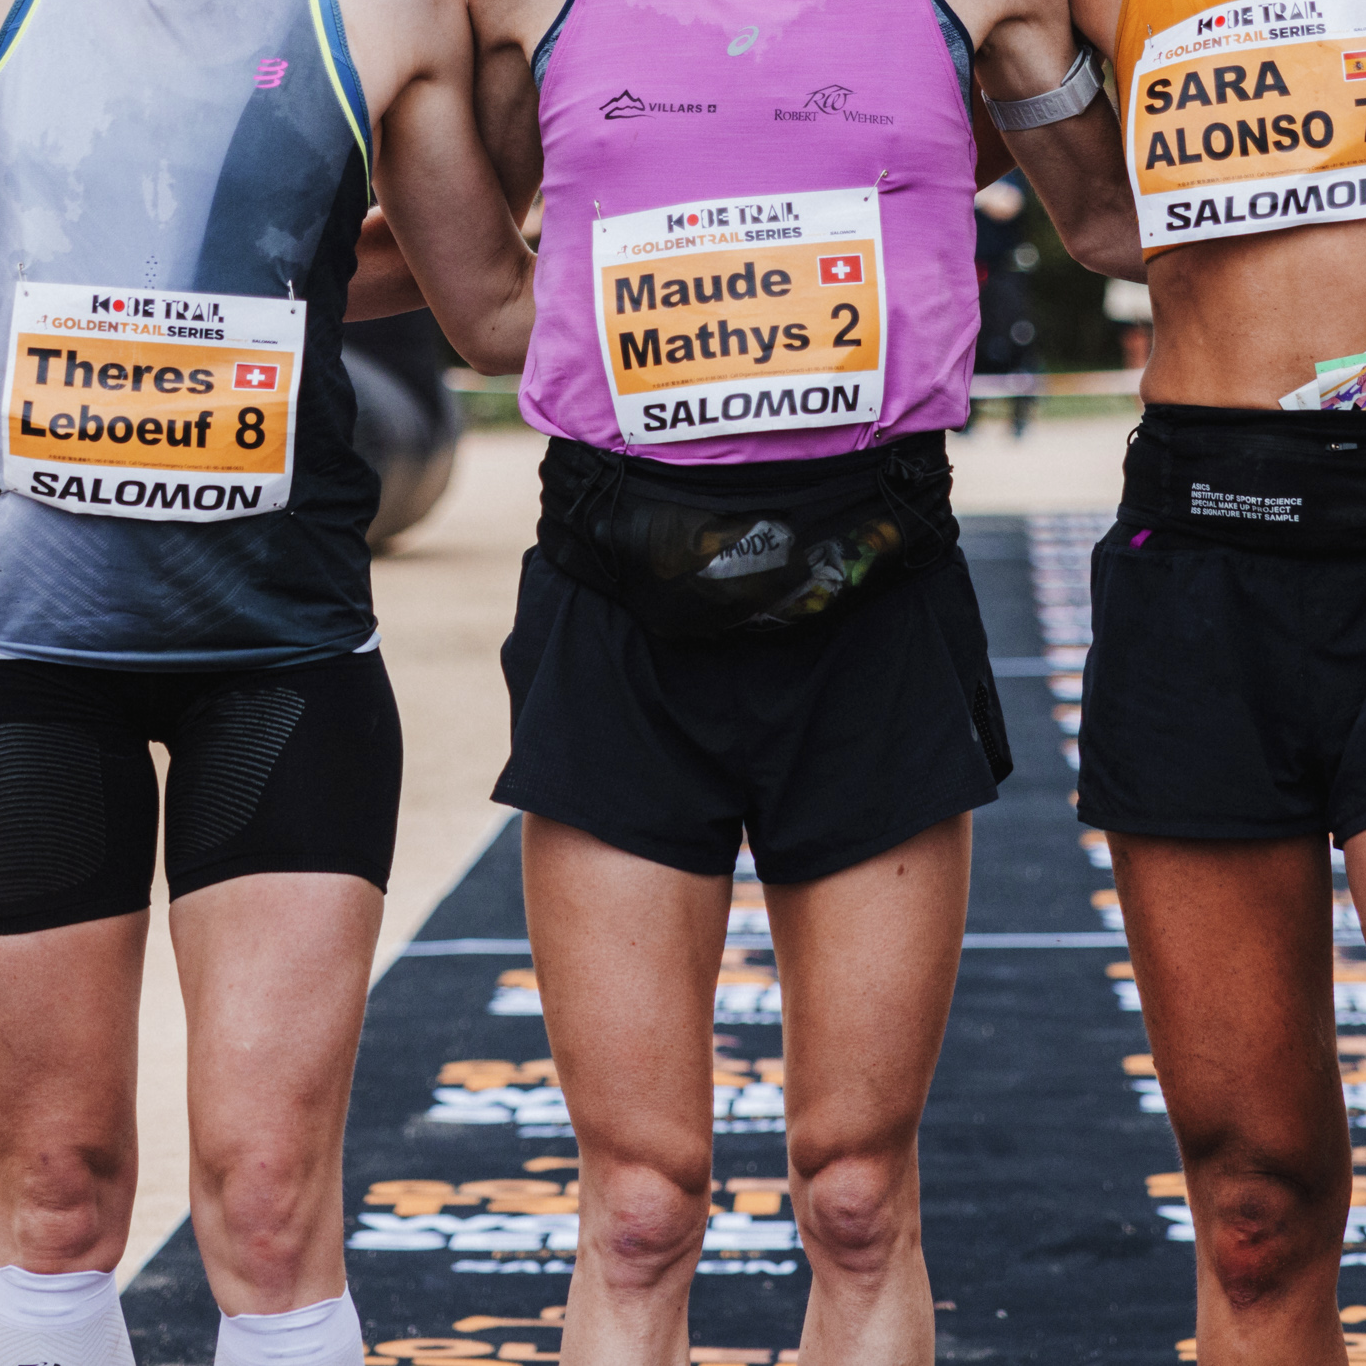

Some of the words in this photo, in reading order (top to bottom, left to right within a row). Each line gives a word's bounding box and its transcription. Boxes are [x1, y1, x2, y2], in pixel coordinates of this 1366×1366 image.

[1258, 0, 1323, 25] TRAIL
[1143, 59, 1291, 116] SARA
[648, 102, 703, 113] VILLARS
[1144, 109, 1334, 170] ALONSO
[735, 202, 800, 226] TRAIL
[614, 261, 793, 316] Maude
[162, 298, 225, 324] TRAIL
[618, 319, 811, 372] Mathys
[829, 302, 863, 348] 2
[26, 347, 216, 396] Theres
[643, 384, 860, 432] SALOMON
[19, 400, 212, 449] Leboeuf
[235, 406, 266, 450] 8
[30, 471, 262, 511] SALOMON
[1191, 483, 1211, 491] ASICS
[1191, 491, 1224, 501] INSTITUTE
[1225, 494, 1234, 502] OF
[1236, 495, 1262, 506] SPORT
[1264, 497, 1302, 506] SCIENCE
[1191, 499, 1217, 508] SPECIAL
[1218, 501, 1238, 510] MAKE
[1239, 503, 1250, 511] UP
[1252, 505, 1291, 514] PROJECT
[1191, 507, 1201, 515] ISS
[1202, 508, 1240, 518] SIGNATURE
[1242, 512, 1262, 520] TEST
[1264, 514, 1299, 522] SAMPLE
